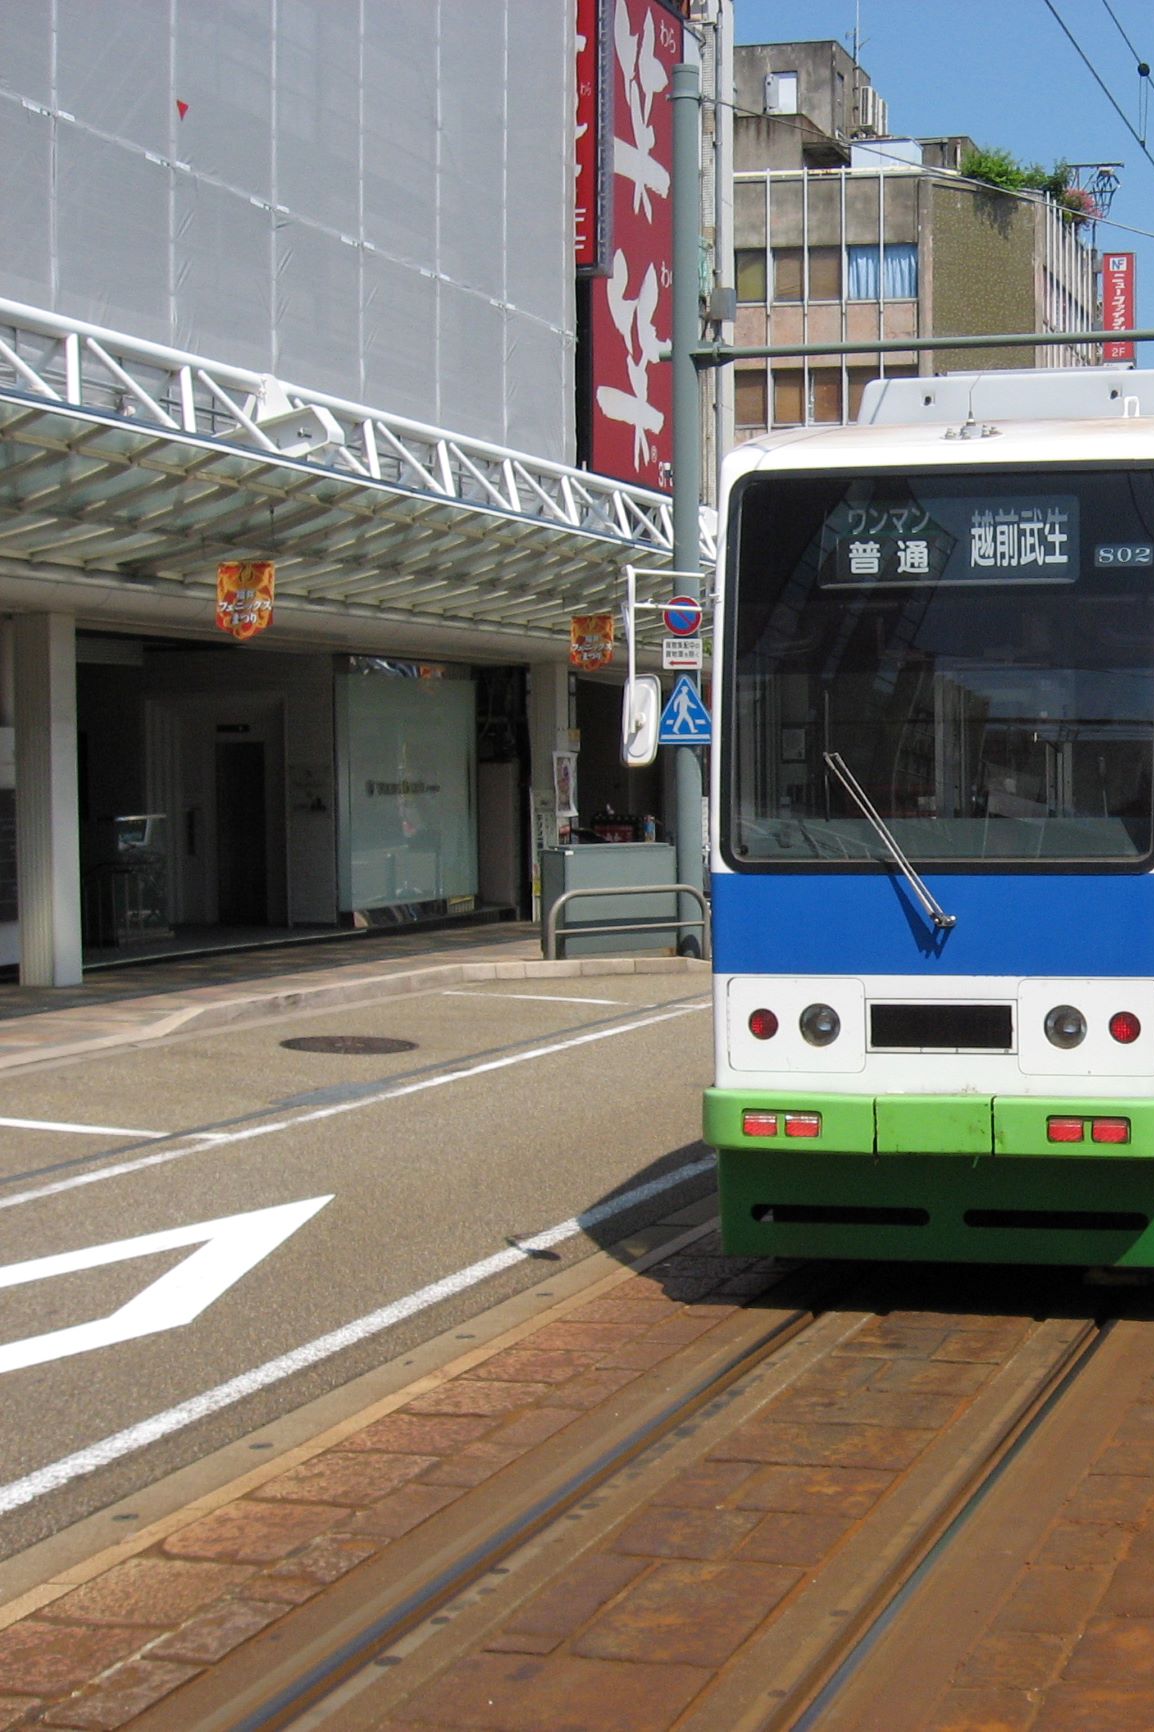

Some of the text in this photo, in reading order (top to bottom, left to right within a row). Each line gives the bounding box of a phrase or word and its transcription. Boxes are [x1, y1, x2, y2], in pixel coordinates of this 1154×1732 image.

[1112, 347, 1126, 357] 2F
[849, 508, 931, 535] ワンマン
[970, 506, 1069, 568] 越前武生
[849, 540, 931, 575] 普通
